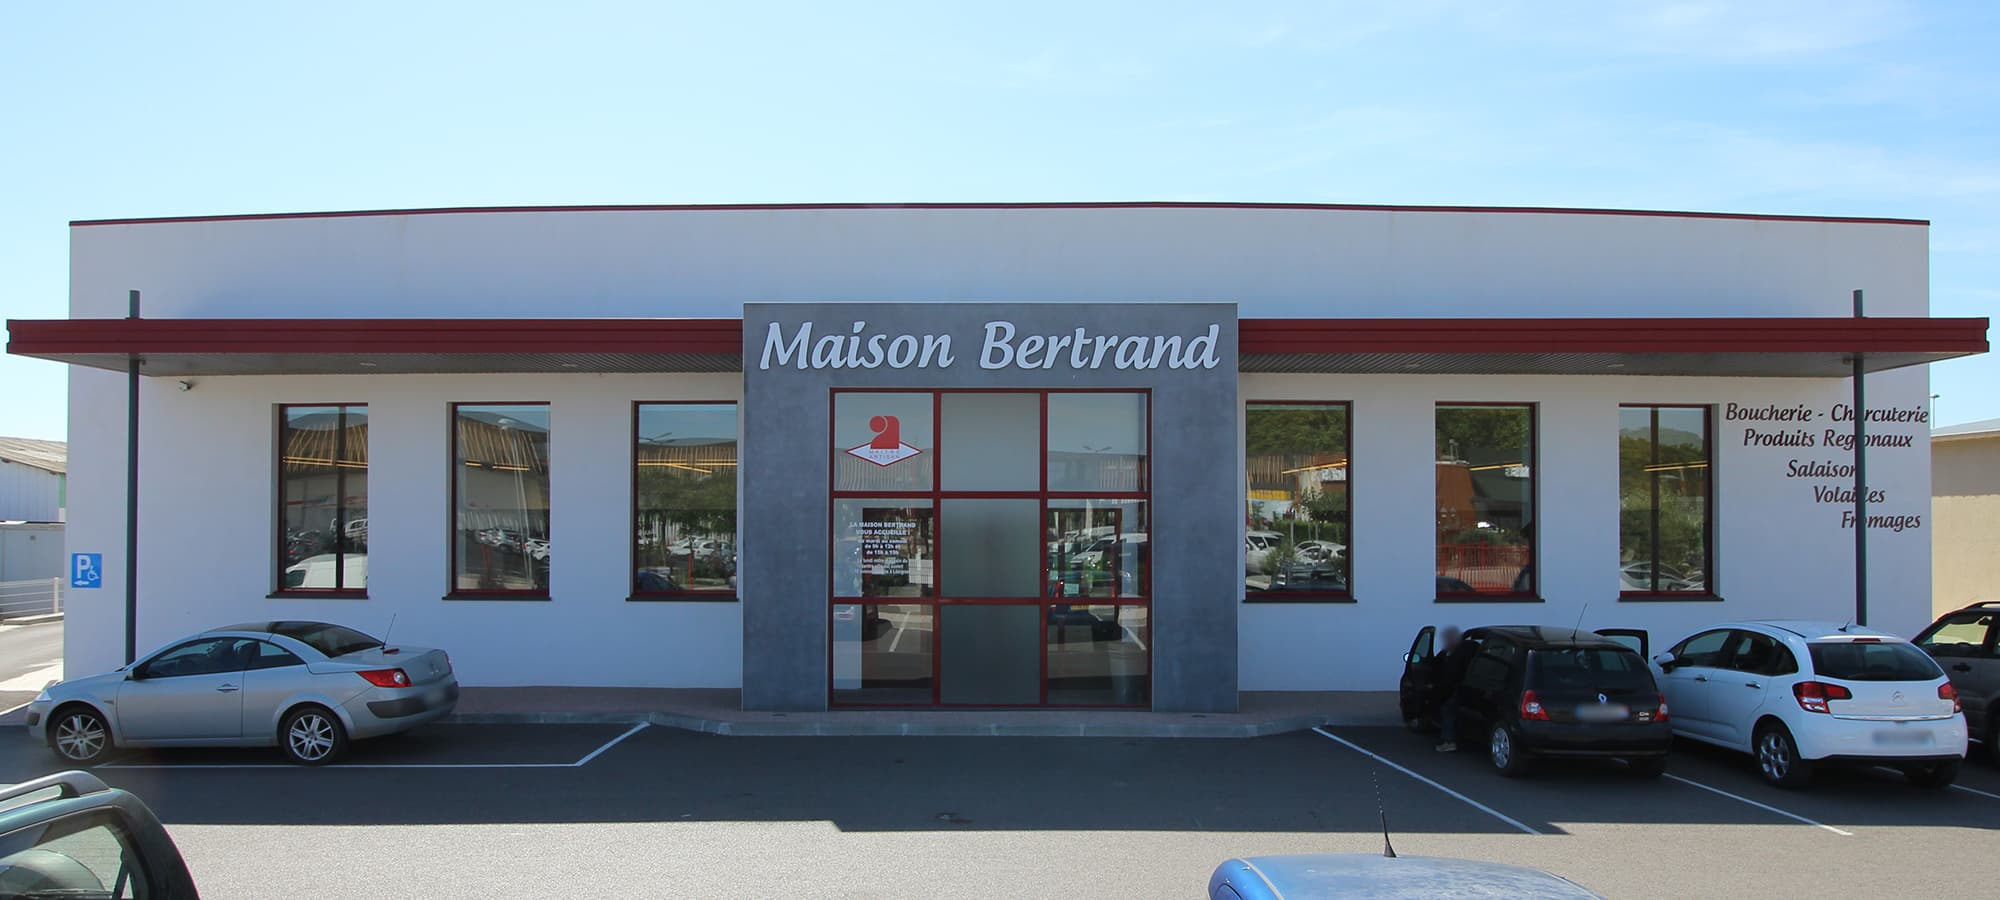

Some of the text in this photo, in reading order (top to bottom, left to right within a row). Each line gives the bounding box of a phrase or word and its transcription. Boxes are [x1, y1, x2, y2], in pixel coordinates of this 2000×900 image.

[759, 320, 1221, 371] Maison Bertrand
[1725, 402, 1813, 423] Boucherie
[1831, 403, 1929, 424] Chrcuterie
[1743, 428, 1913, 451] Produits Regonaux
[1814, 485, 1885, 503] Volailes
[1841, 511, 1921, 533] Frmages
[77, 555, 91, 579] P
